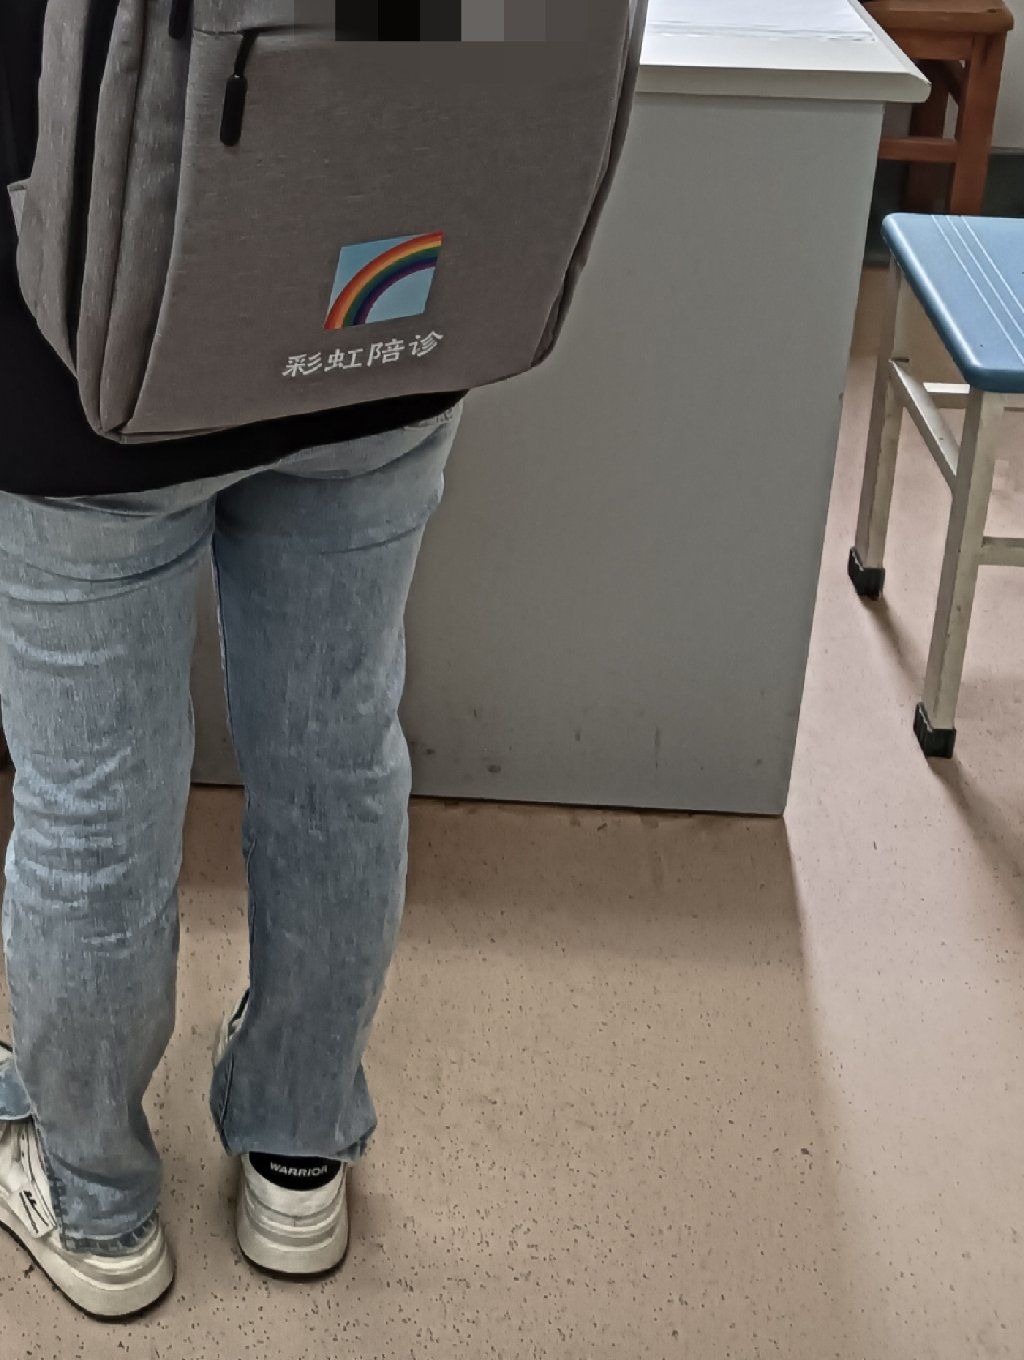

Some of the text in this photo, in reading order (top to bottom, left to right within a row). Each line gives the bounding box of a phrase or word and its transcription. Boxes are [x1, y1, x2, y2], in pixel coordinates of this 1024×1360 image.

[282, 331, 444, 377] 彩虹陪诊
[270, 1161, 328, 1177] WARRIOR
